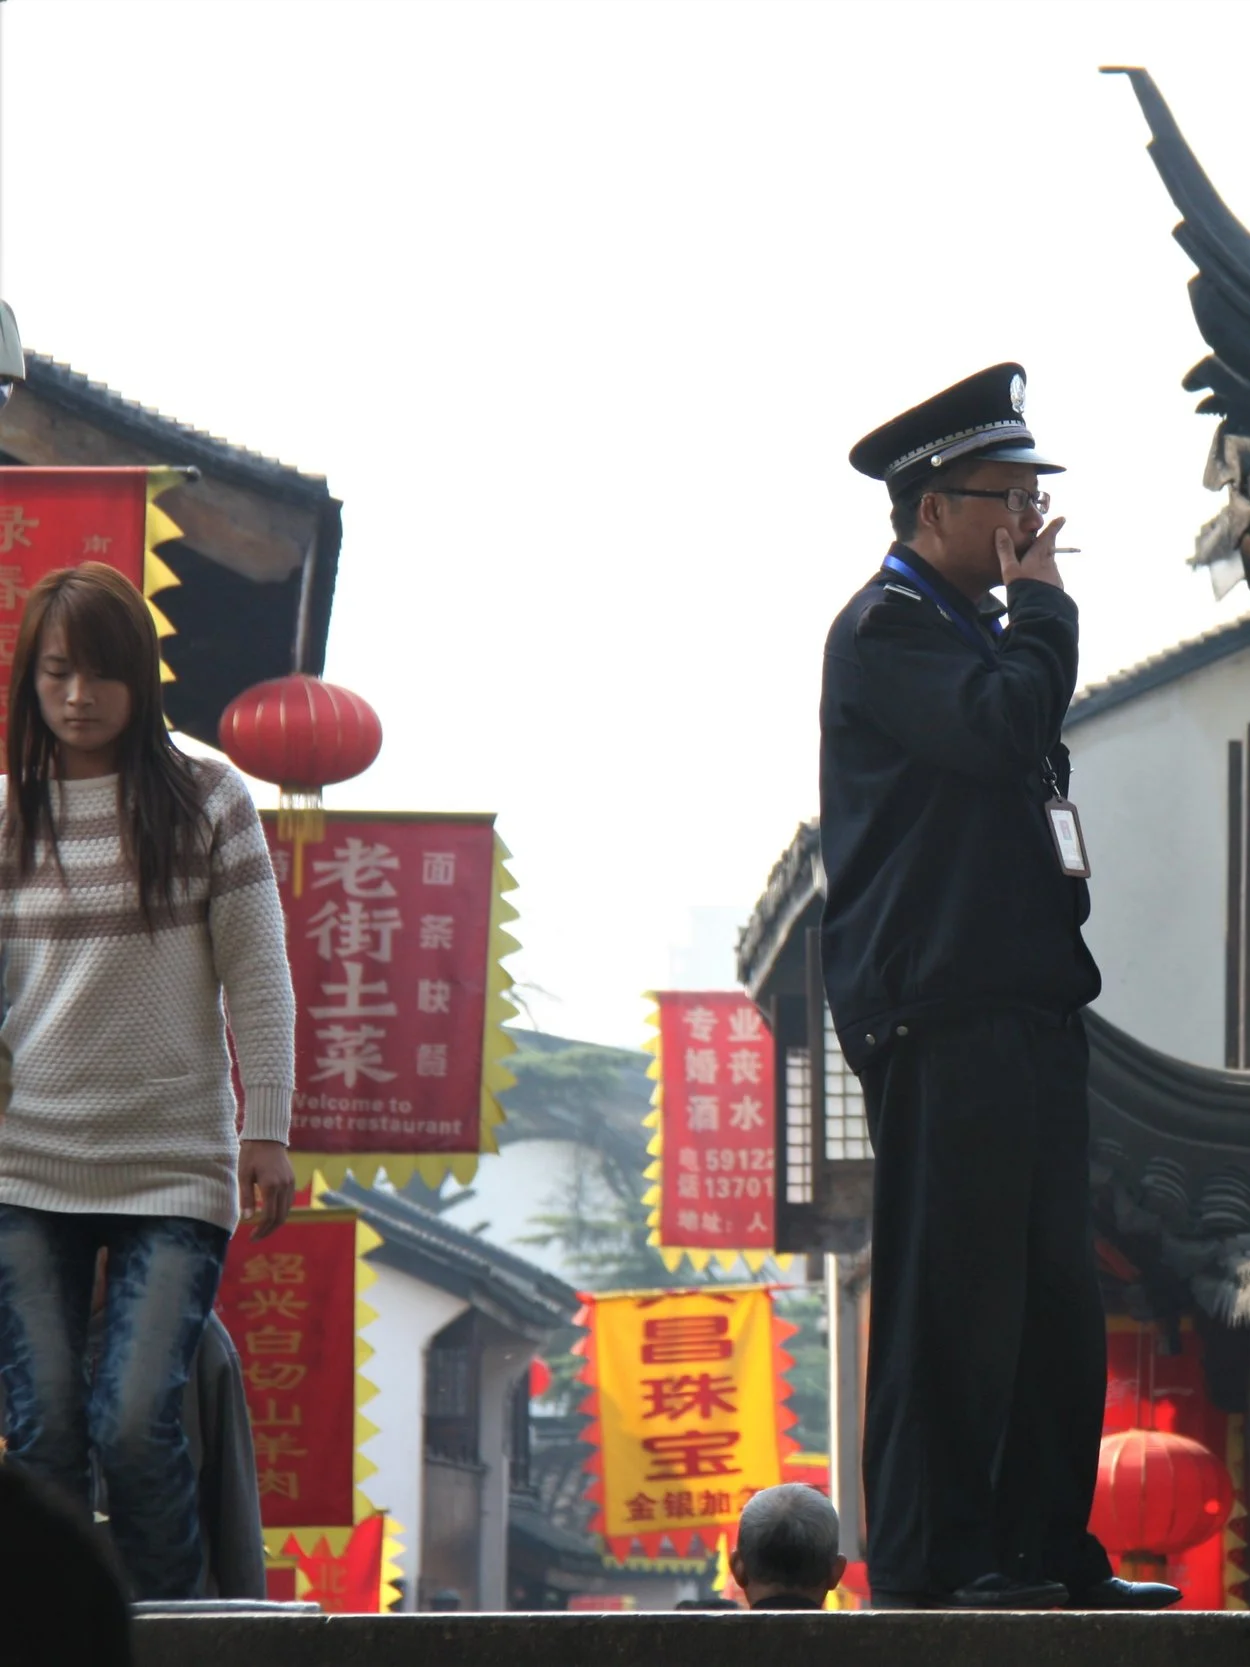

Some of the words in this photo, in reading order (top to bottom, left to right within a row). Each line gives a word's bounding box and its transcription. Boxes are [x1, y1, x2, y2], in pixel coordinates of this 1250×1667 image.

[304, 837, 403, 1089] 老街土菜
[682, 1006, 764, 1042] 专业
[388, 1096, 413, 1114] to
[686, 1095, 765, 1131] 酒水
[292, 1113, 342, 1130] treet
[347, 1115, 463, 1135] restaurant
[239, 1253, 309, 1500] 绍兴白切山羊肉
[638, 1292, 742, 1481] 昌珠宝
